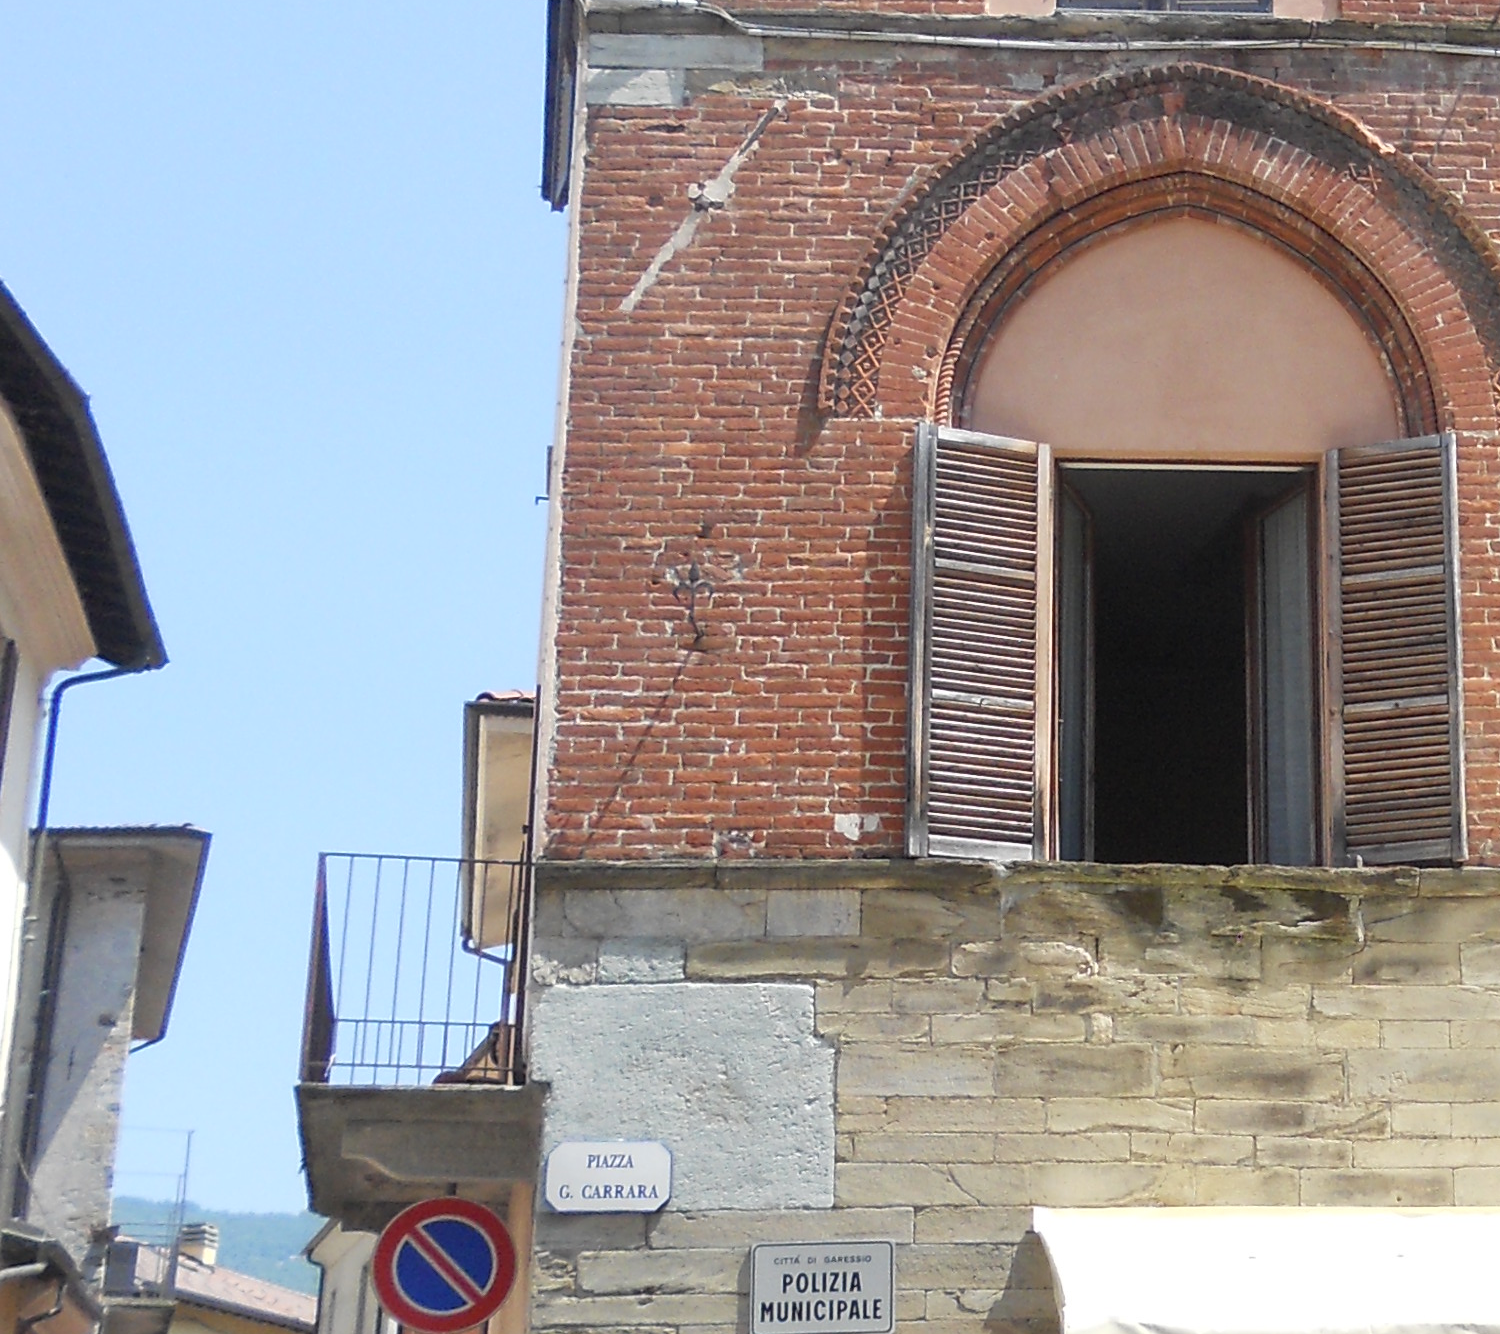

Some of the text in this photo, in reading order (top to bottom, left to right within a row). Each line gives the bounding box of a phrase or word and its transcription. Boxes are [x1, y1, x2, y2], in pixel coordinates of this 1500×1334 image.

[586, 1154, 634, 1169] PIAZZA
[559, 1184, 659, 1199] G. CARRARA
[807, 1256, 817, 1264] DI
[823, 1255, 872, 1264] GARESSIO
[782, 1271, 862, 1294] POLIZIA
[760, 1298, 883, 1323] MUNICIPALE
